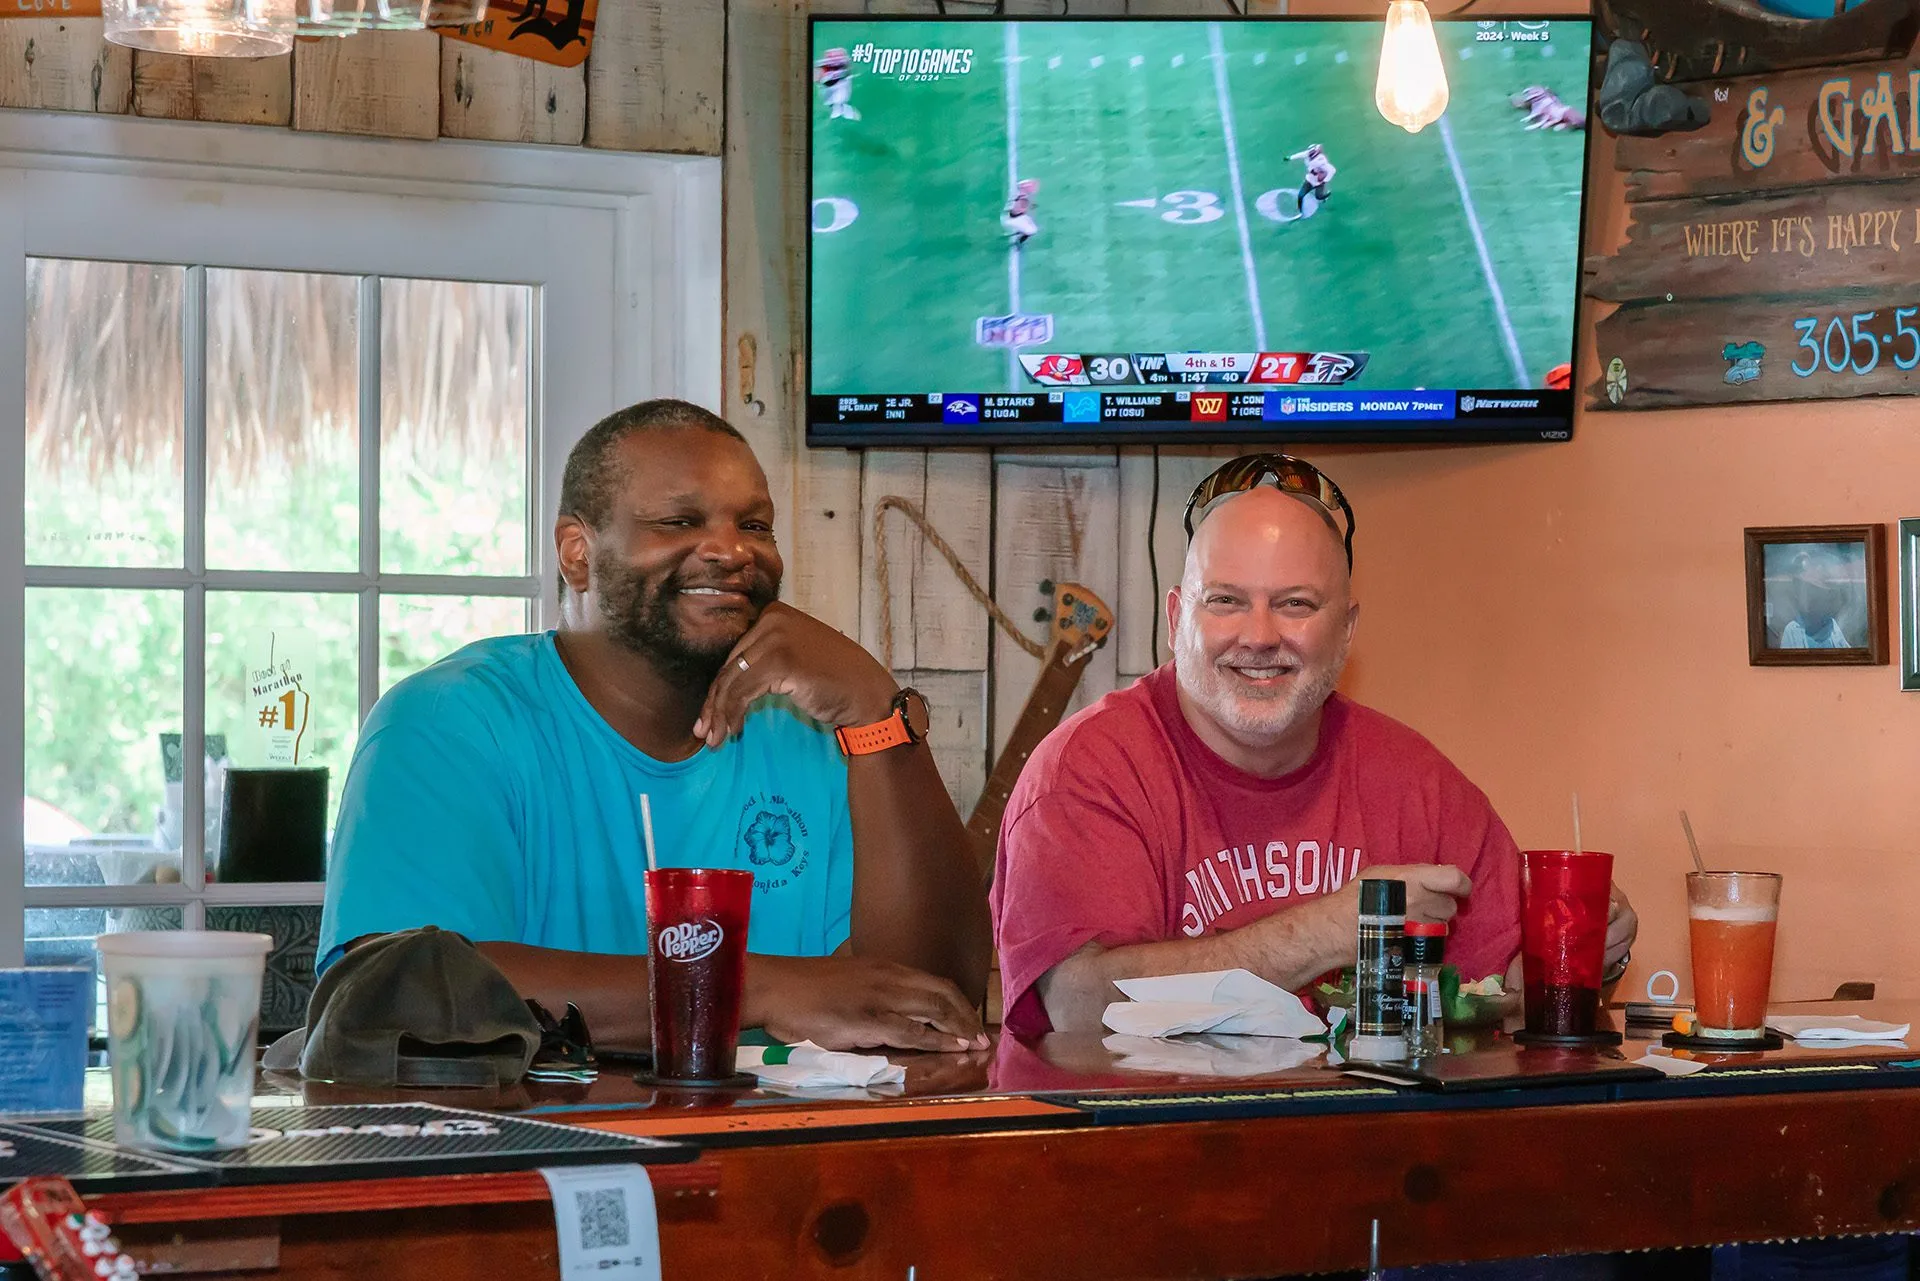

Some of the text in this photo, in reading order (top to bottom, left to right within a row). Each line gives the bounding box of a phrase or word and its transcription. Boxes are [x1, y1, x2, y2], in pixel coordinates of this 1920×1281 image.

[1476, 31, 1550, 41] 2024 Week 5
[851, 42, 874, 63] #9
[898, 74, 940, 82] OF 2024
[1741, 86, 1786, 168] &
[1683, 219, 1760, 263] WHERE
[1771, 216, 1816, 258] IT'S
[1827, 209, 1903, 256] HAPPY
[1089, 357, 1130, 381] 30
[1139, 356, 1166, 370] TNF
[1185, 356, 1236, 368] 4th & 15
[1260, 357, 1298, 379] 27
[1149, 372, 1240, 382] 4TH 1:47 40
[984, 397, 1035, 407] M. STARKS
[1105, 396, 1162, 406] T. WILLIAMS
[1297, 402, 1354, 413] INSIDERS
[1360, 401, 1410, 412] MONDAY
[1475, 399, 1540, 409] NETWORK
[984, 409, 992, 418] S
[1540, 431, 1568, 439] VIZIO
[252, 674, 303, 697] Marathon
[259, 689, 295, 731] #1
[1181, 840, 1362, 938] SMITHSONI
[679, 922, 702, 941] Dr
[664, 926, 719, 958] Pepper
